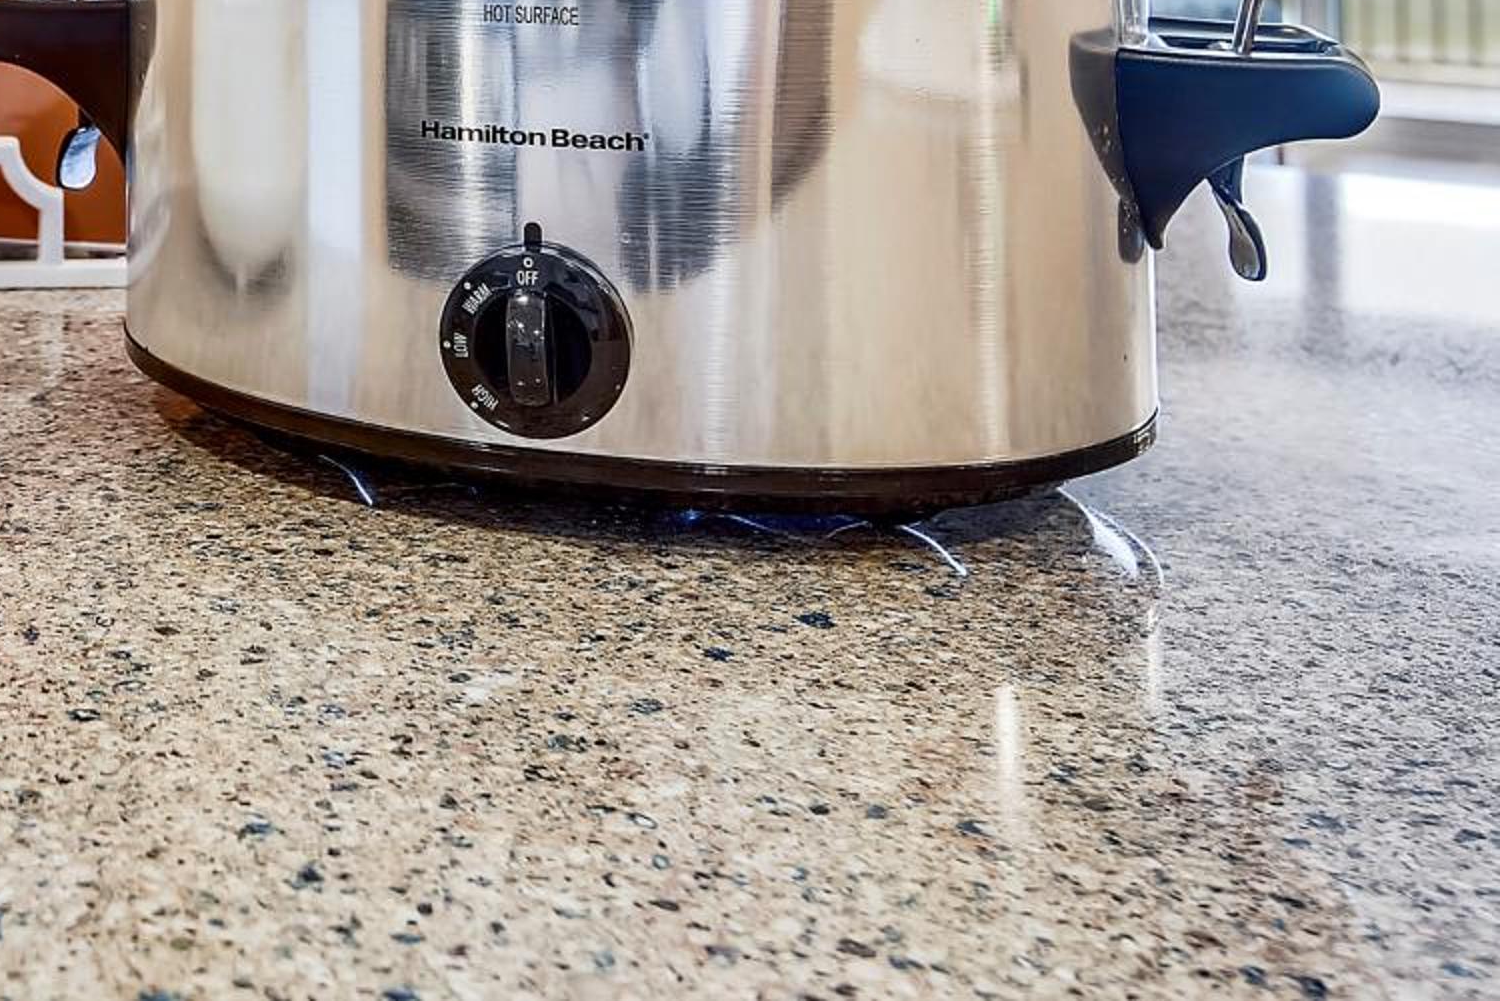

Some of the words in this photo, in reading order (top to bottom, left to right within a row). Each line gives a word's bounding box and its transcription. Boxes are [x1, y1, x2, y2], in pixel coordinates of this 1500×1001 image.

[483, 3, 512, 24] HOT
[515, 5, 580, 27] SURFACE
[420, 120, 547, 147] Hamilton
[550, 129, 645, 152] Beach
[515, 270, 539, 286] OFF
[461, 282, 494, 316] WARM
[453, 331, 470, 359] LOW
[471, 383, 501, 412] HIGH
